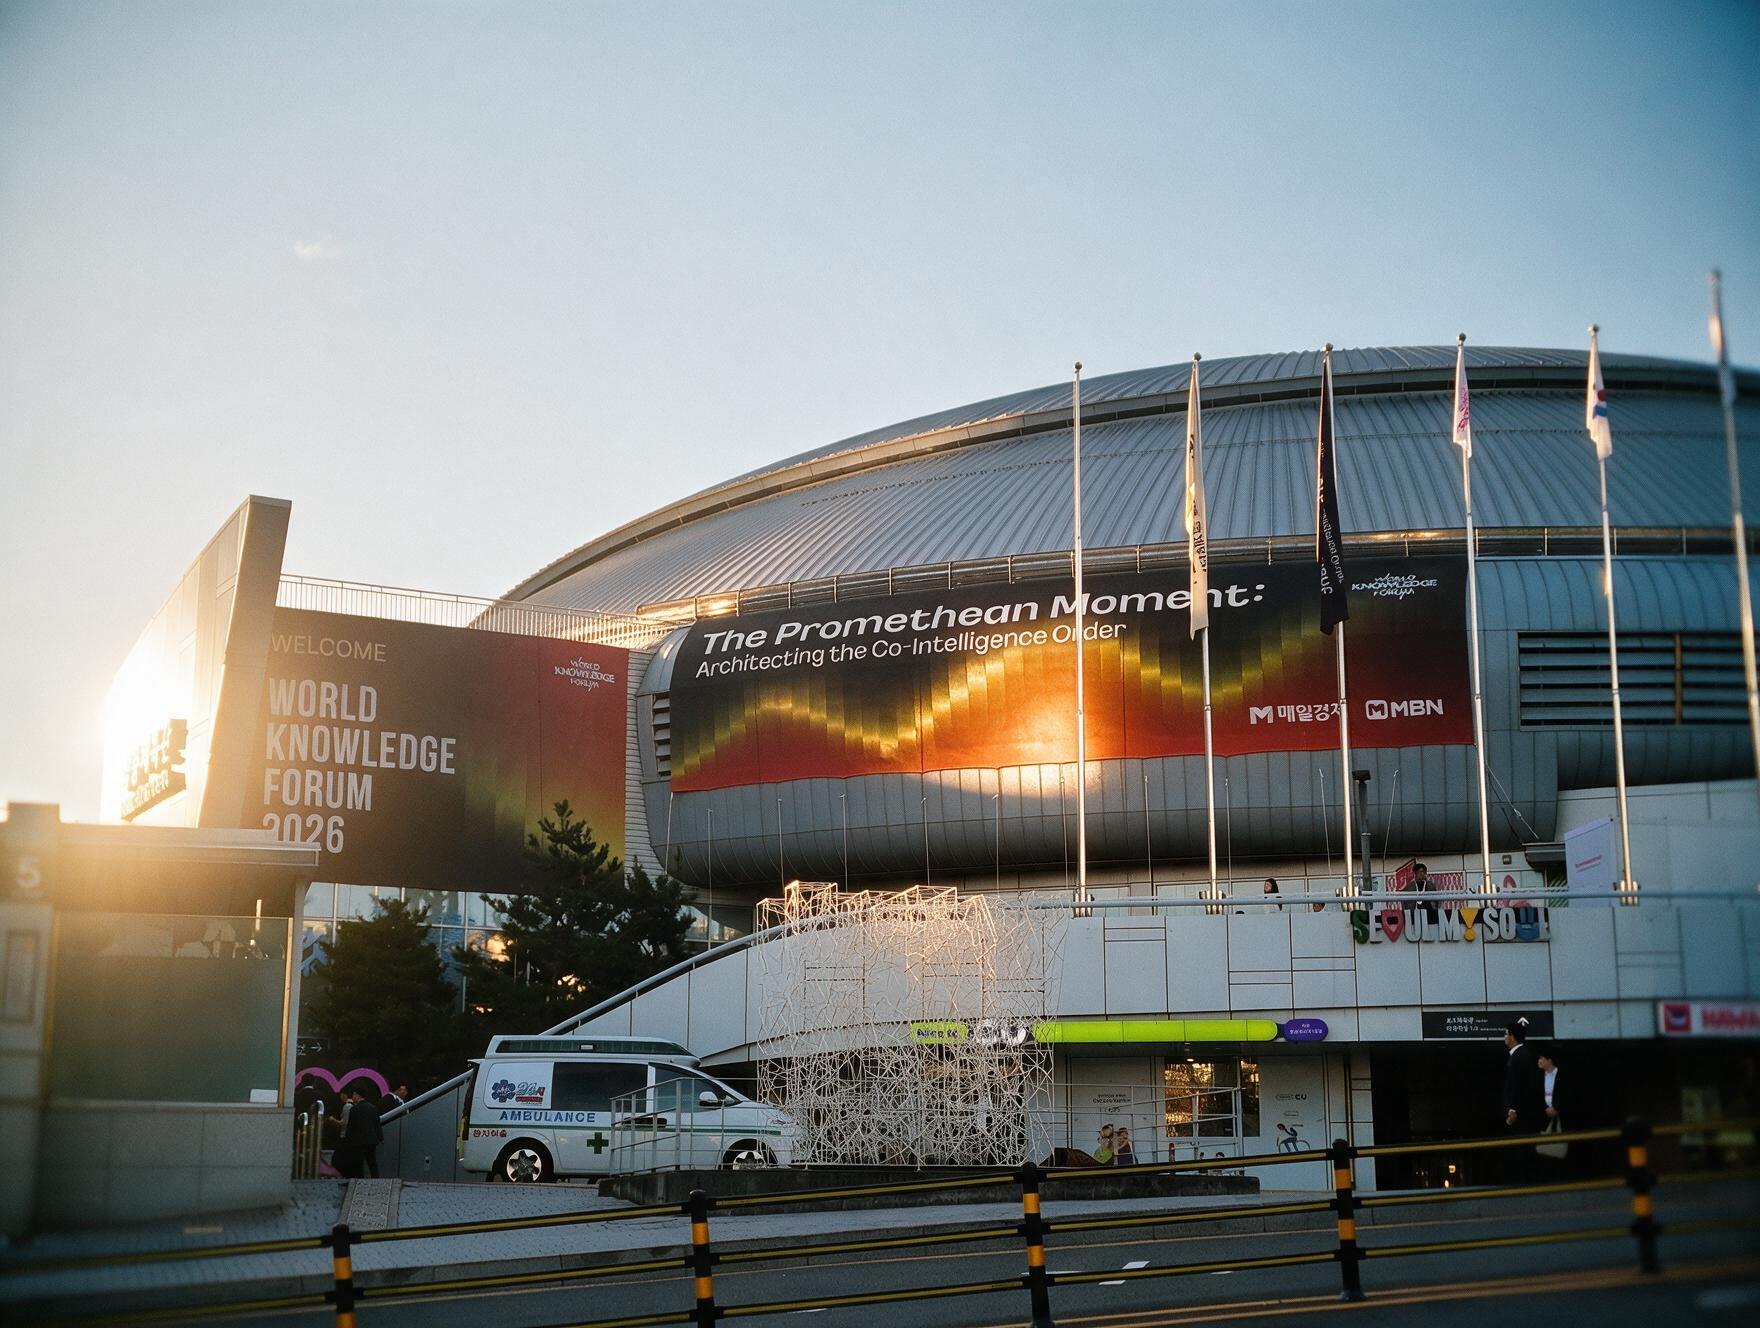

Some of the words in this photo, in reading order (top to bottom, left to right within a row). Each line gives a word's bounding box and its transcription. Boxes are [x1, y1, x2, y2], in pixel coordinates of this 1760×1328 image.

[1352, 579, 1438, 591] KNOWLEDGE
[703, 628, 766, 655] The
[774, 600, 1039, 646] Promethean
[1050, 583, 1265, 619] Moment:
[271, 634, 387, 663] WELCOME
[569, 657, 601, 671] WORLD
[695, 646, 825, 678] Architecting
[829, 643, 867, 663] the
[871, 629, 1048, 659] Co-Intelligence
[1052, 621, 1127, 644] Order
[554, 666, 615, 684] KNOWLEDGE
[269, 678, 377, 723] WORLD
[1391, 699, 1444, 718] MBN
[265, 723, 456, 775] KNOWLEDGE
[263, 767, 373, 811] FORUM
[262, 812, 345, 854] 2026
[16, 857, 41, 888] 5
[499, 1110, 596, 1123] AMBULANCE
